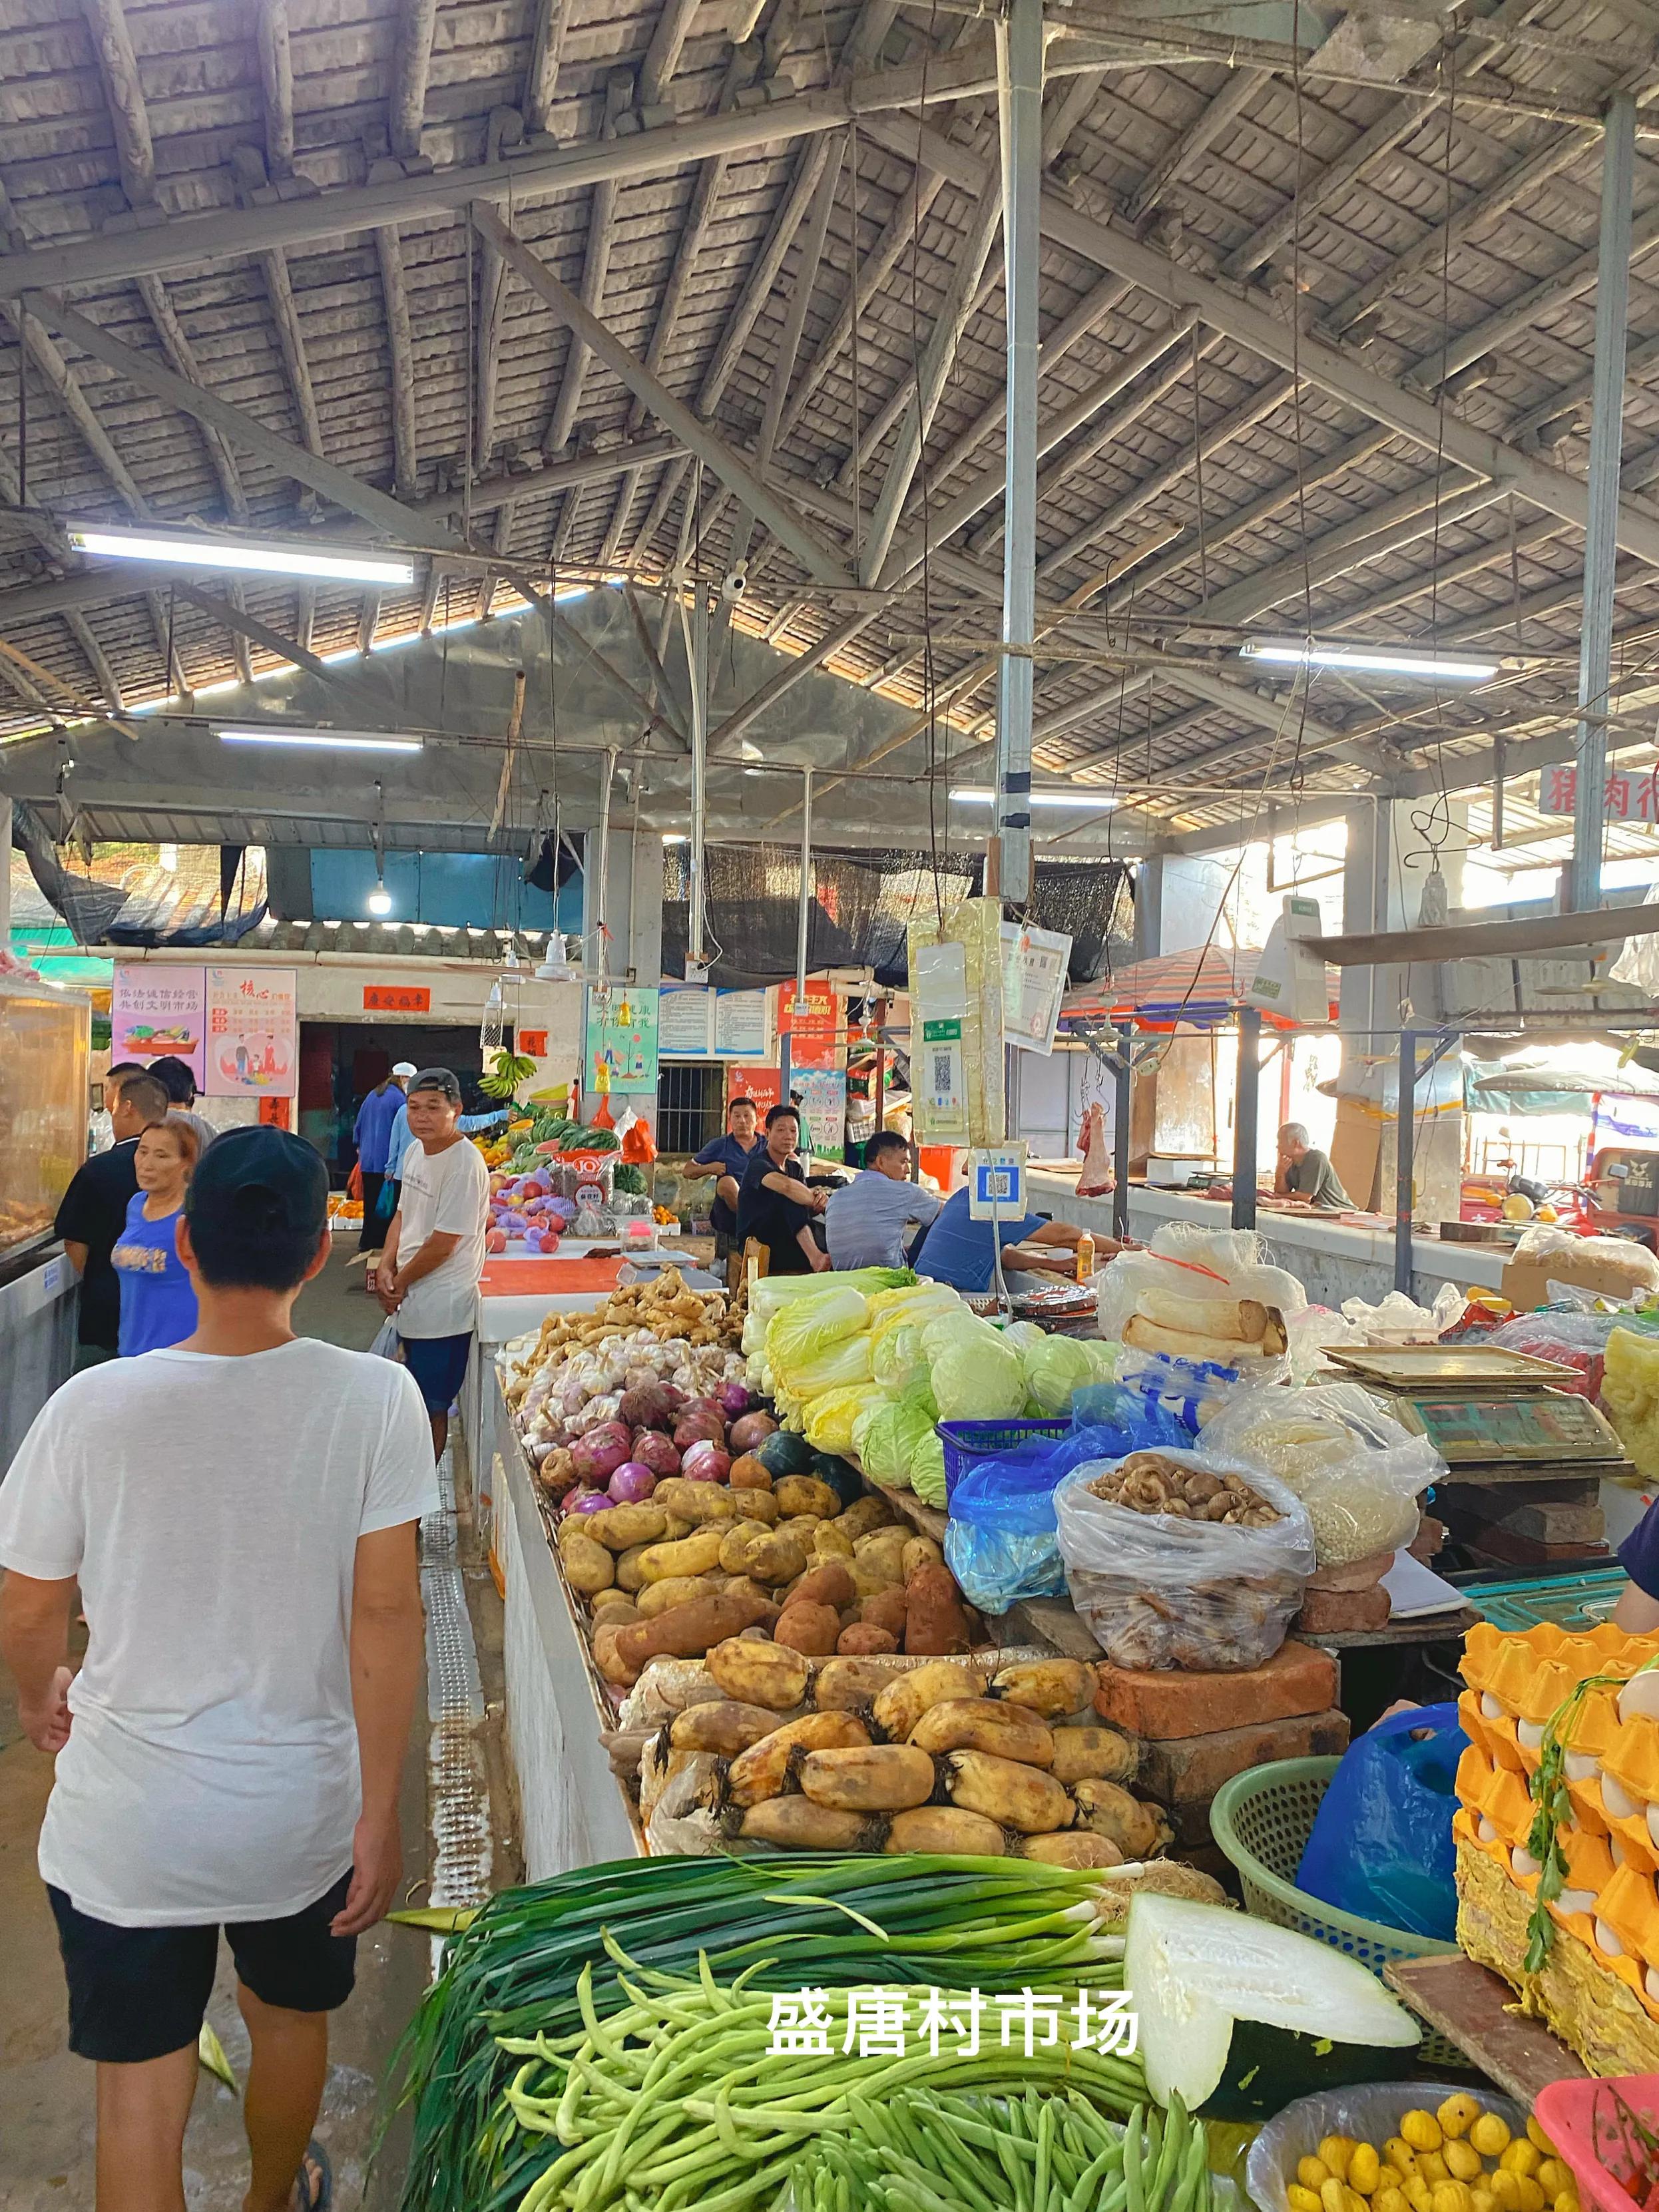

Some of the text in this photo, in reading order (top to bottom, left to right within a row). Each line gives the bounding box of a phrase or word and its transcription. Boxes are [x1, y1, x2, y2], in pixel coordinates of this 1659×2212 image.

[240, 979, 270, 999] 核心
[119, 1000, 198, 1010] 共创文明市场
